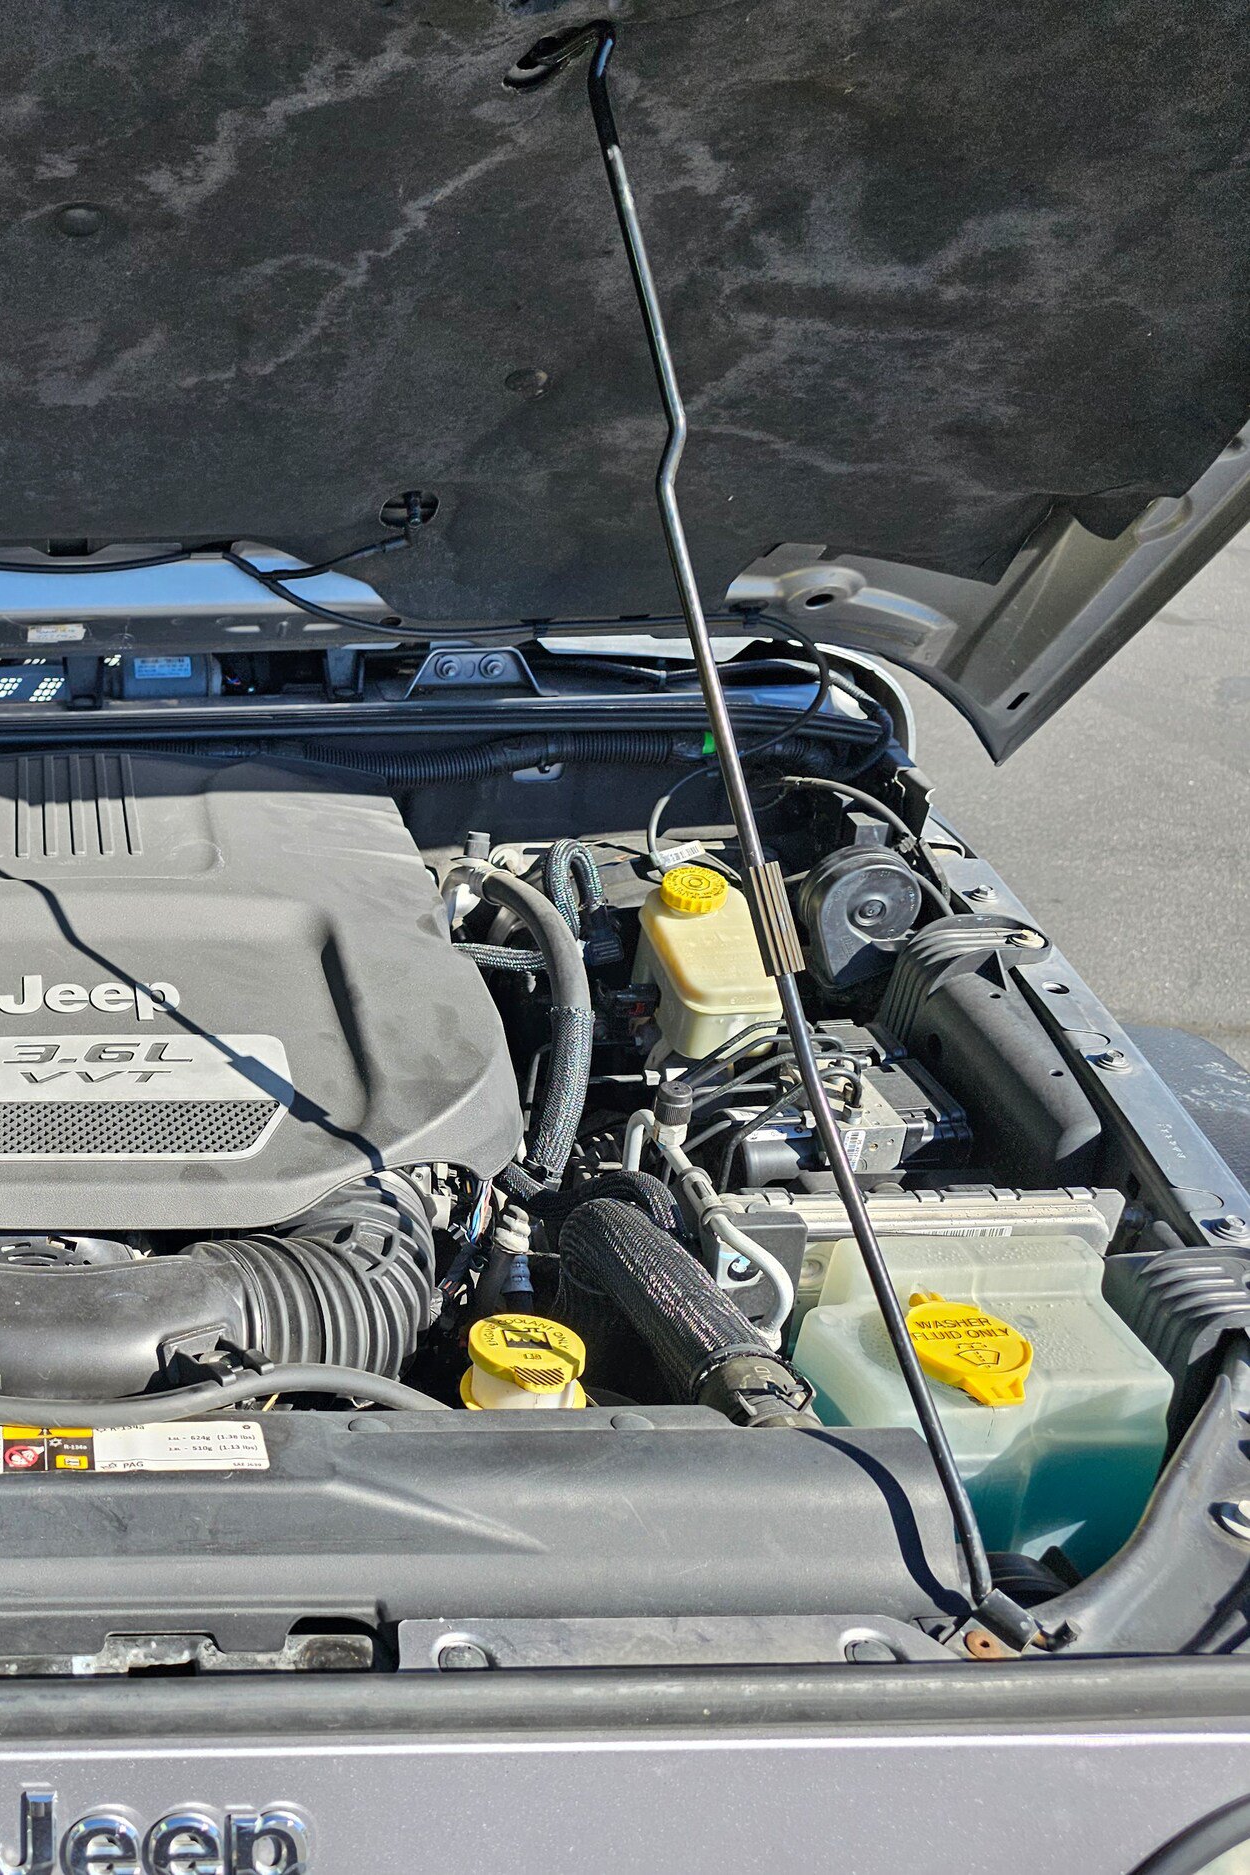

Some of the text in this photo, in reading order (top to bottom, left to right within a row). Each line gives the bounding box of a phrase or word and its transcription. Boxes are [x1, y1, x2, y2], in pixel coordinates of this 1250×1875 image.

[3, 1042, 193, 1063] 3.6L
[19, 1070, 172, 1083] VVT
[915, 1317, 992, 1330] WASHER
[497, 1318, 555, 1331] COOLANT
[553, 1331, 570, 1350] ONLY
[911, 1328, 1011, 1342] FLUID ONLY
[123, 1461, 144, 1469] PAG
